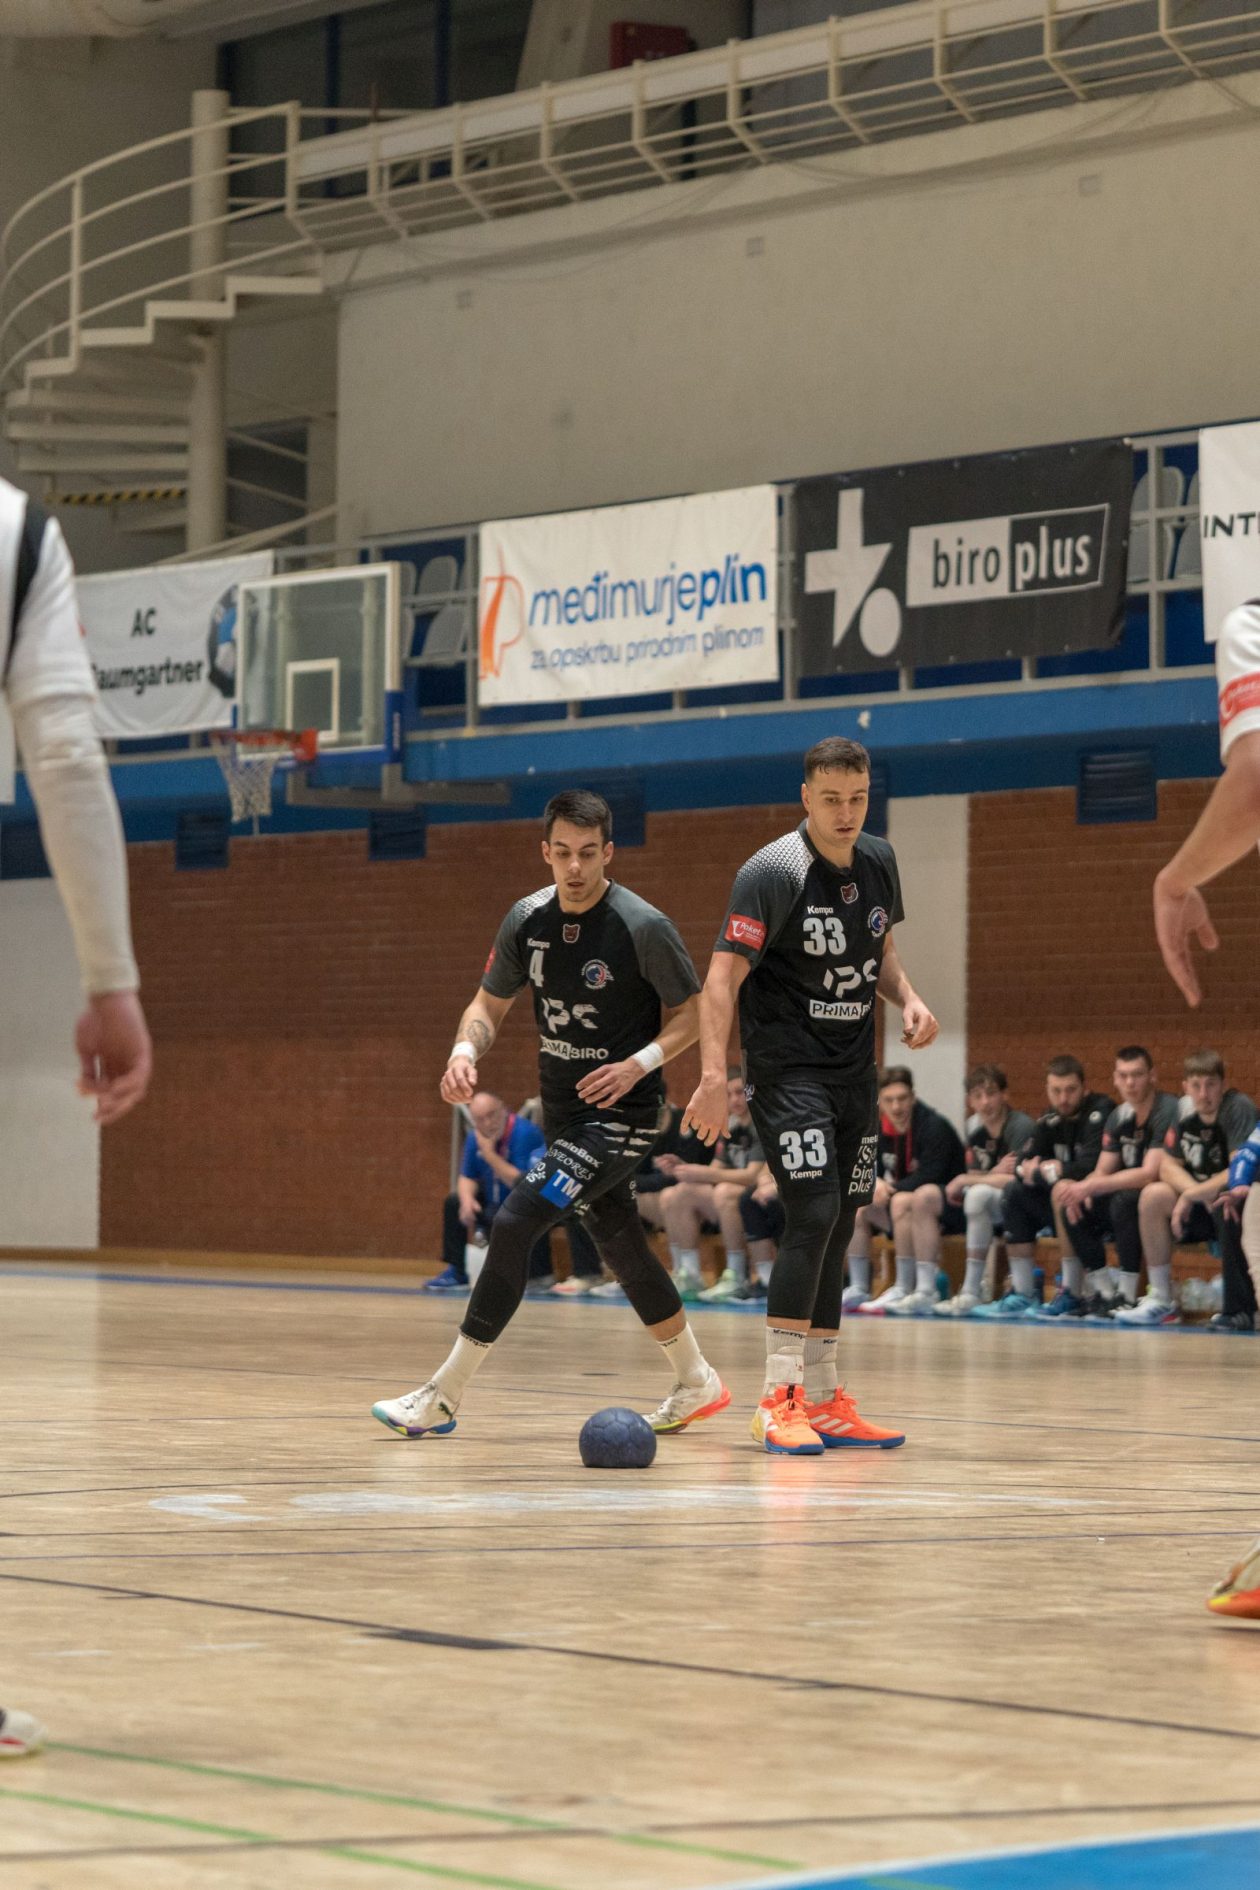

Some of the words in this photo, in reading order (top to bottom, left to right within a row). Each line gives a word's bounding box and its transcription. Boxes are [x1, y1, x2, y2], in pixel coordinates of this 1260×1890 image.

[1203, 510, 1260, 539] INT
[130, 607, 156, 638] AC
[92, 656, 203, 696] aumgartner
[807, 905, 834, 916] Kempa
[803, 917, 847, 956] 33
[529, 949, 545, 988] 4
[779, 1128, 828, 1171] 33
[552, 1168, 583, 1199] TM
[790, 1169, 823, 1181] Kempa
